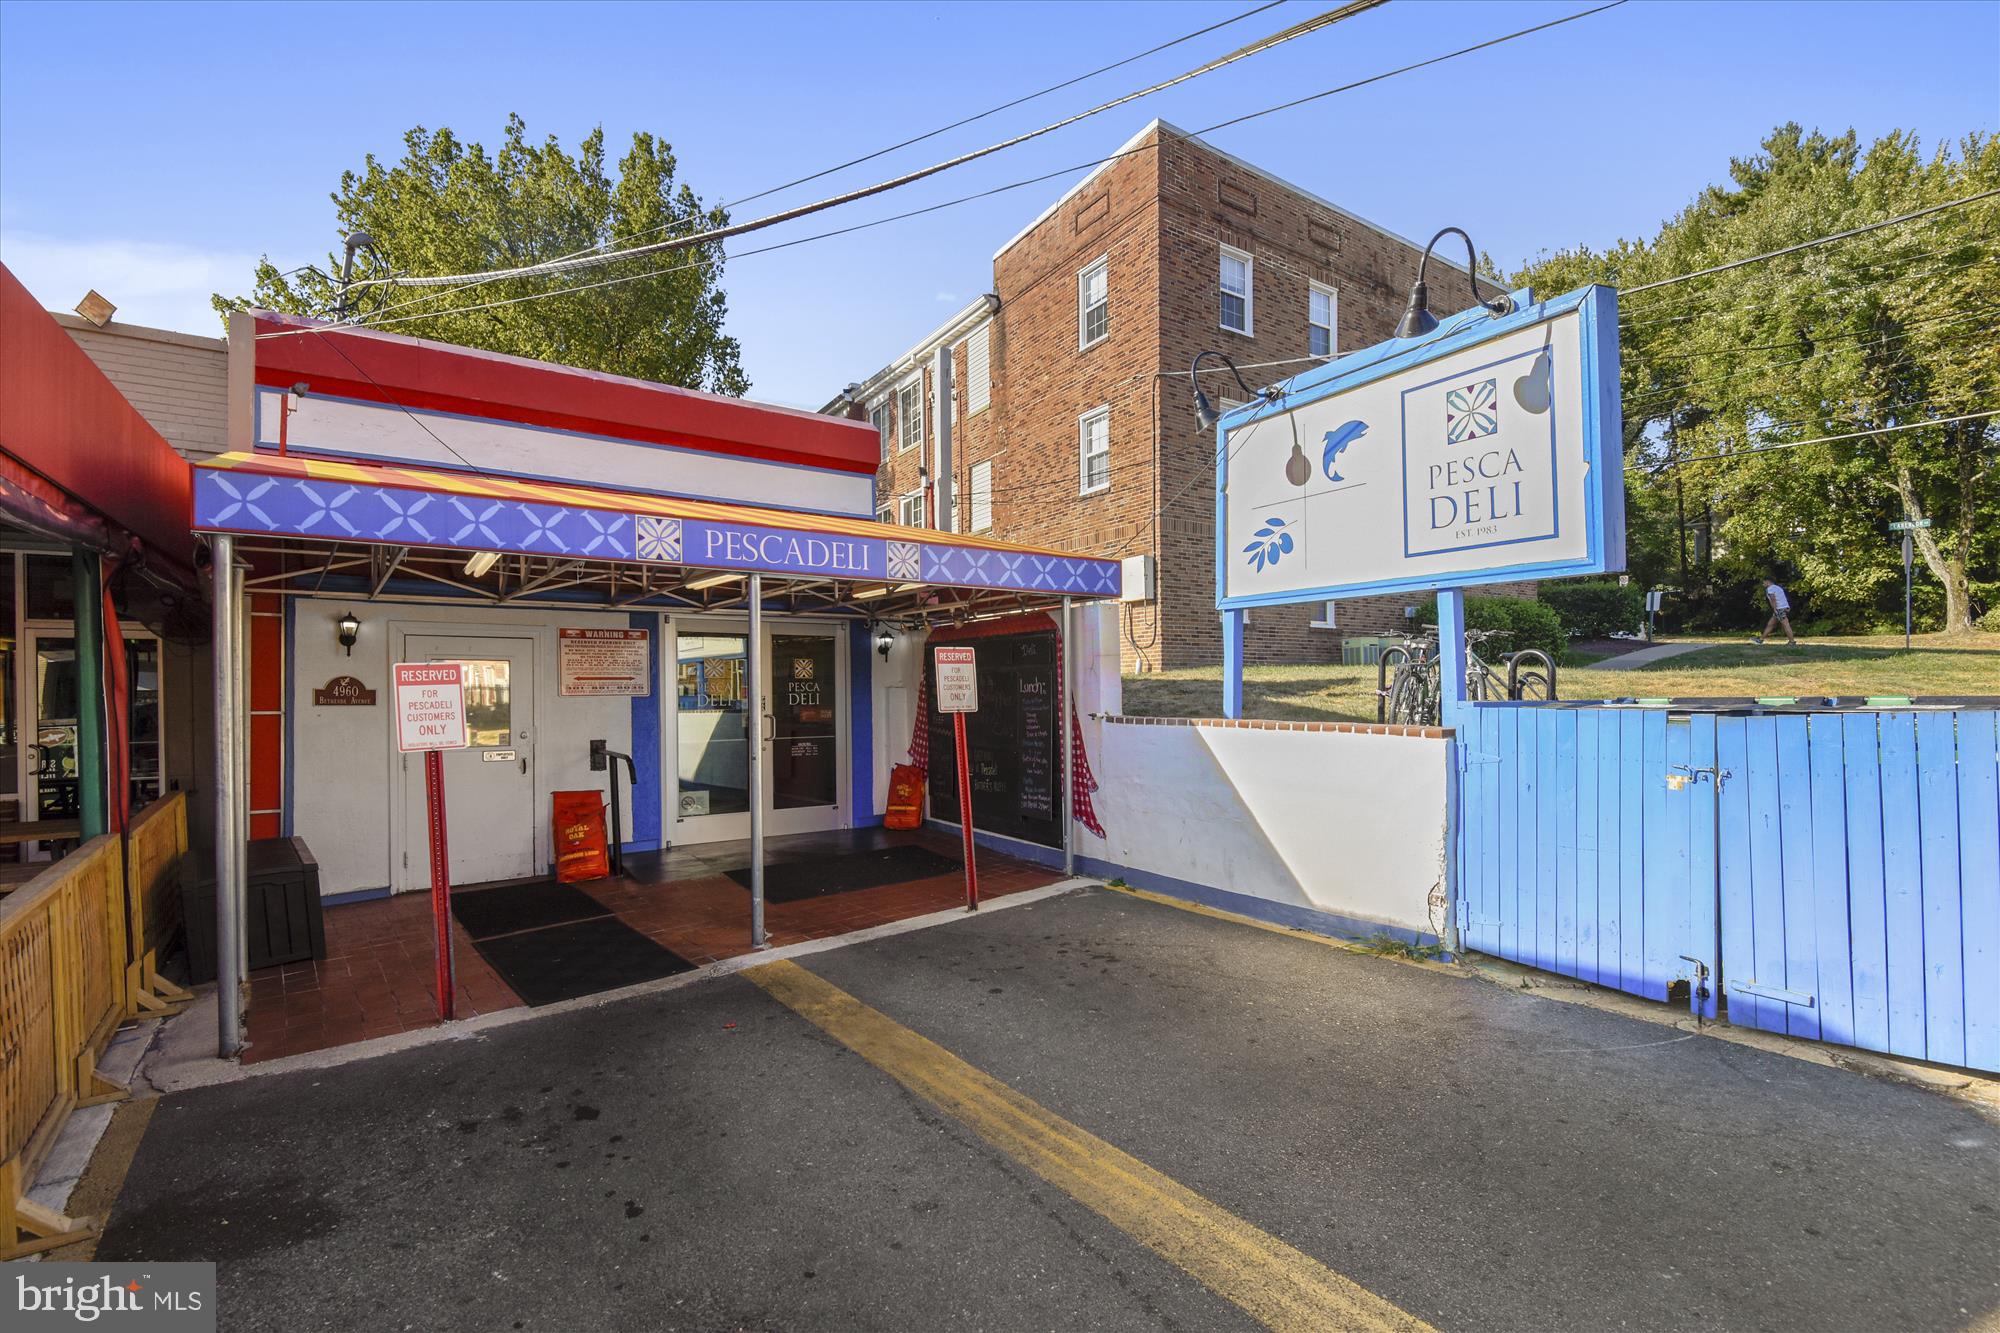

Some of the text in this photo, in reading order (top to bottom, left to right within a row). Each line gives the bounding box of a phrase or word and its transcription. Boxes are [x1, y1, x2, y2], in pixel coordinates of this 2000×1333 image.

[1429, 447, 1524, 490] PESCA
[1429, 480, 1524, 530] DELI
[1476, 525, 1498, 536] 1983
[705, 528, 871, 571] PESCADELI
[584, 629, 624, 639] WARNING
[940, 652, 971, 661] RESERVED
[401, 669, 457, 682] RESERVED
[333, 685, 359, 697] 4960
[788, 682, 820, 692] PESCA
[422, 689, 438, 698] FOR
[950, 692, 966, 701] ONLY
[697, 693, 732, 707] DELI
[789, 693, 820, 706] DELI
[408, 700, 453, 711] PESCADELI
[407, 712, 456, 722] CUSTOMERS
[419, 724, 446, 736] ONLY
[568, 831, 585, 840] OAK
